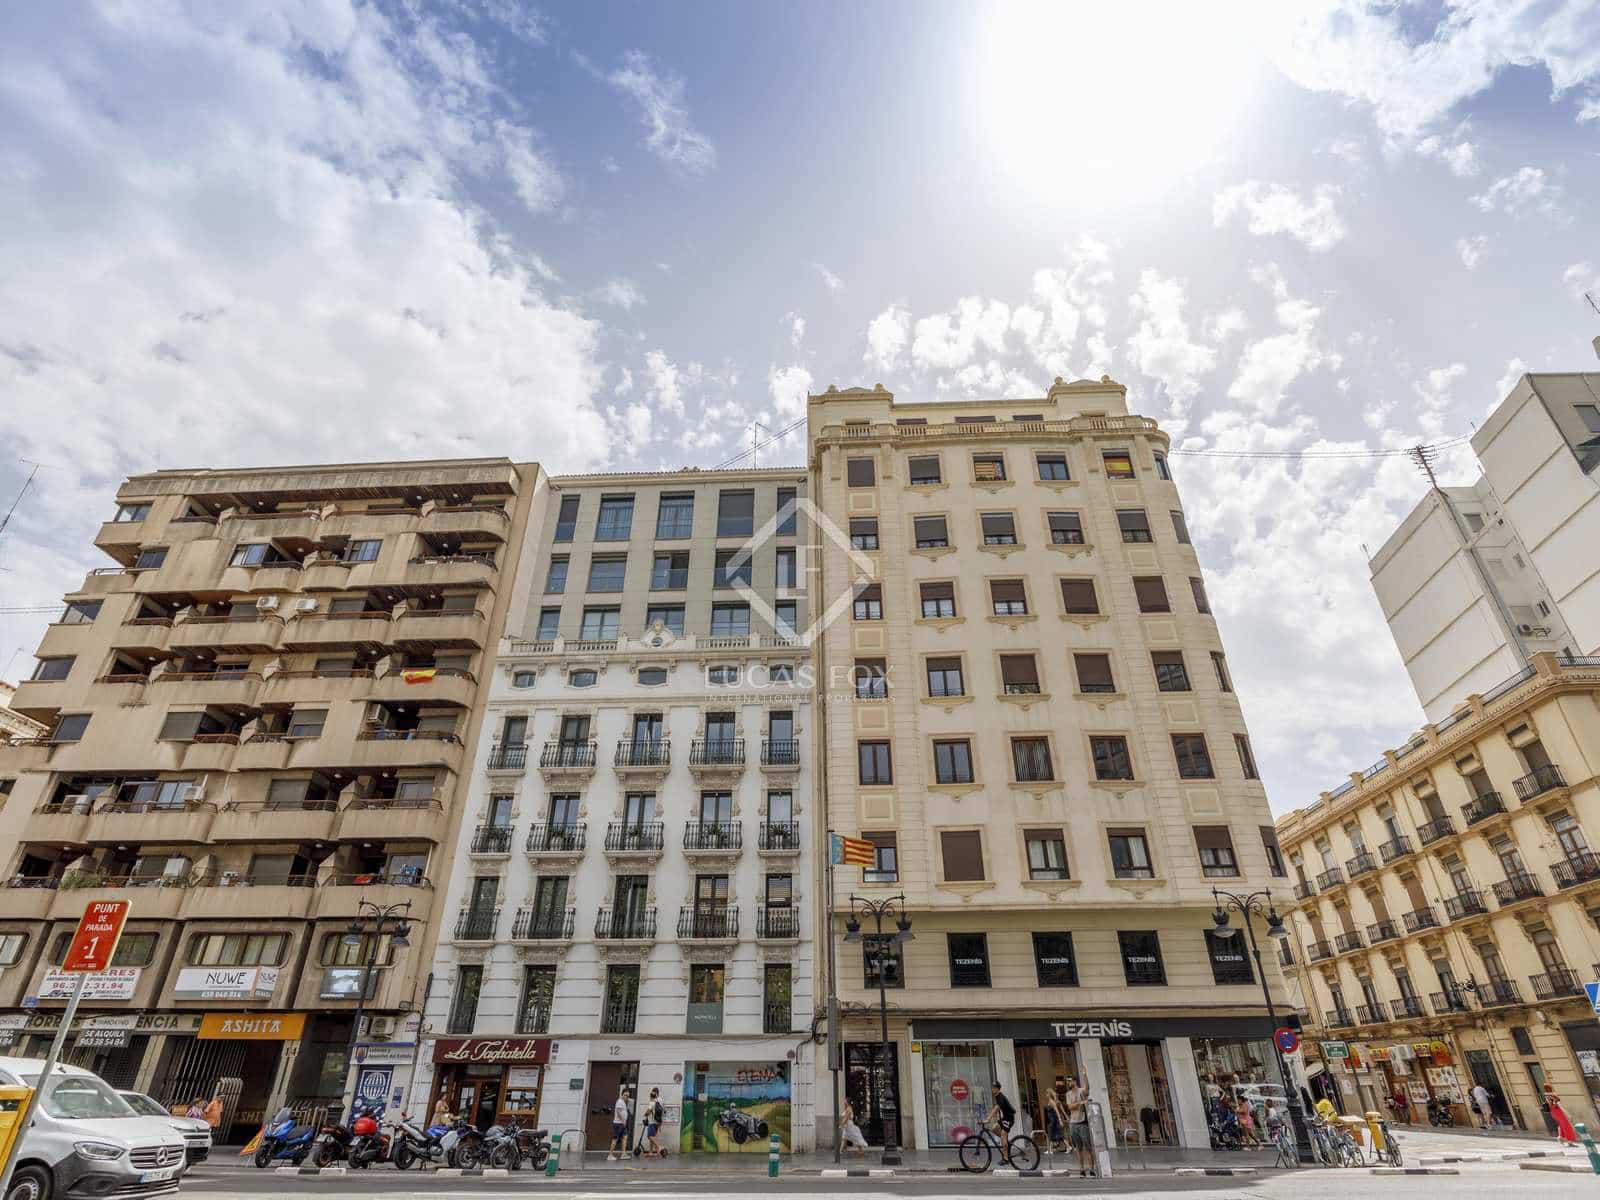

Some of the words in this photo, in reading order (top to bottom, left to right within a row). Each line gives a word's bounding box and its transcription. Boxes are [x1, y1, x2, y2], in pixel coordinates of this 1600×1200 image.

[93, 903, 120, 913] PUNT
[85, 923, 113, 931] PARADA
[205, 971, 247, 985] NUWE
[221, 1020, 283, 1033] ASHITA
[1050, 1018, 1132, 1037] TEZENIS
[84, 1030, 95, 1038] SE
[95, 1030, 125, 1038] ALQUILA
[444, 1040, 469, 1060] La
[471, 1039, 537, 1062] Tagliatella
[609, 1045, 621, 1056] 12
